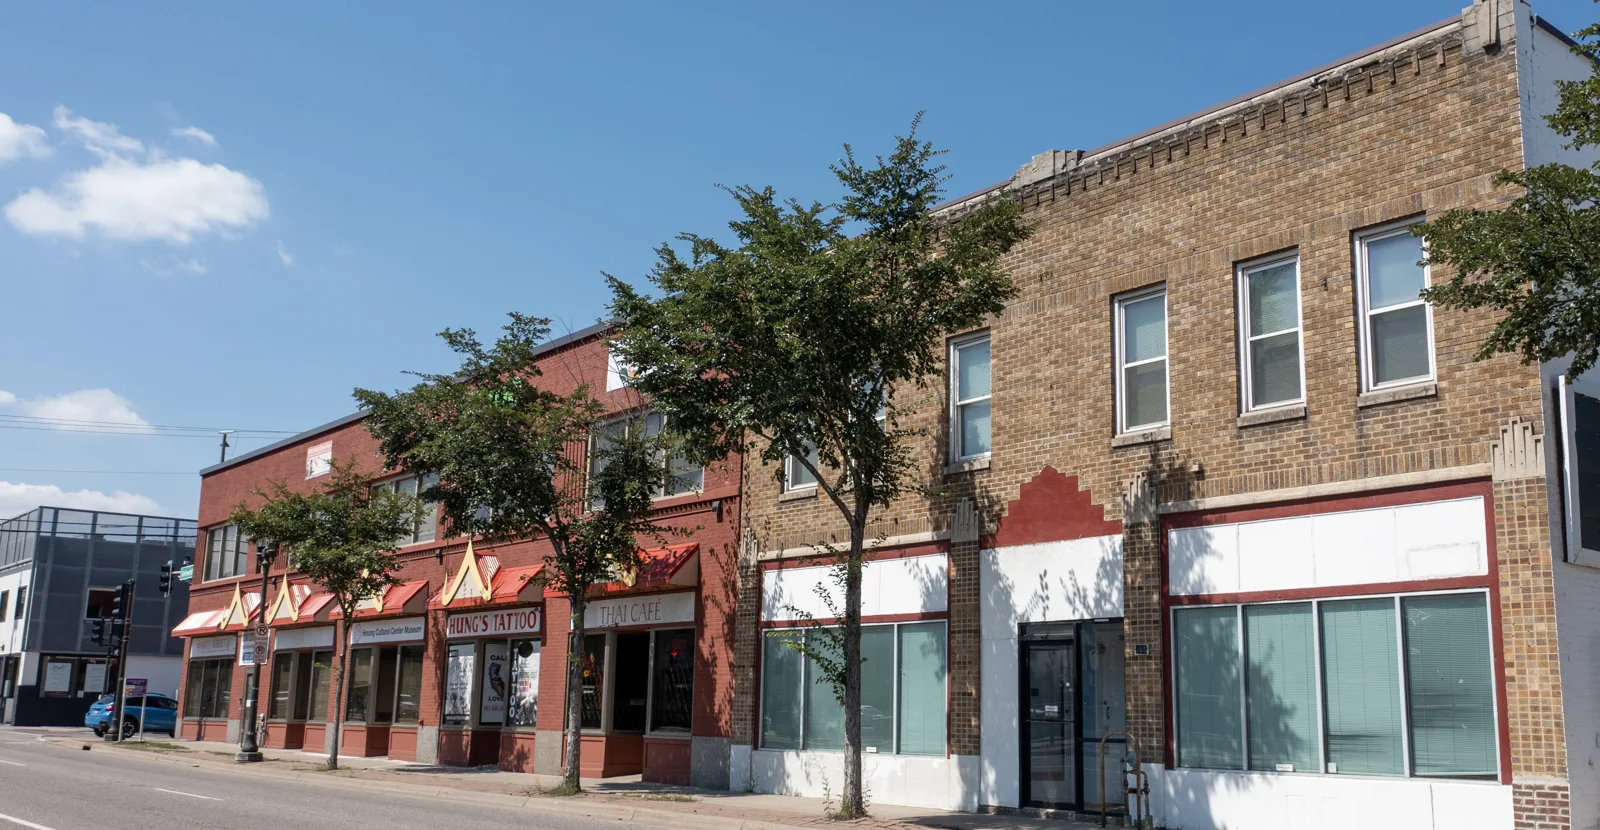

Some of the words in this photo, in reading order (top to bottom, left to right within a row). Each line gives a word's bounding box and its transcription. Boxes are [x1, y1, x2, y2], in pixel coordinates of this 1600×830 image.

[449, 615, 488, 634] HUNG'S
[493, 610, 537, 631] TATTOO
[600, 604, 626, 624] THAI
[630, 598, 661, 622] CAFÉ
[362, 629, 375, 638] Hmong
[376, 627, 390, 636] Cultural
[391, 627, 404, 635] Center
[509, 648, 519, 718] TATTOO
